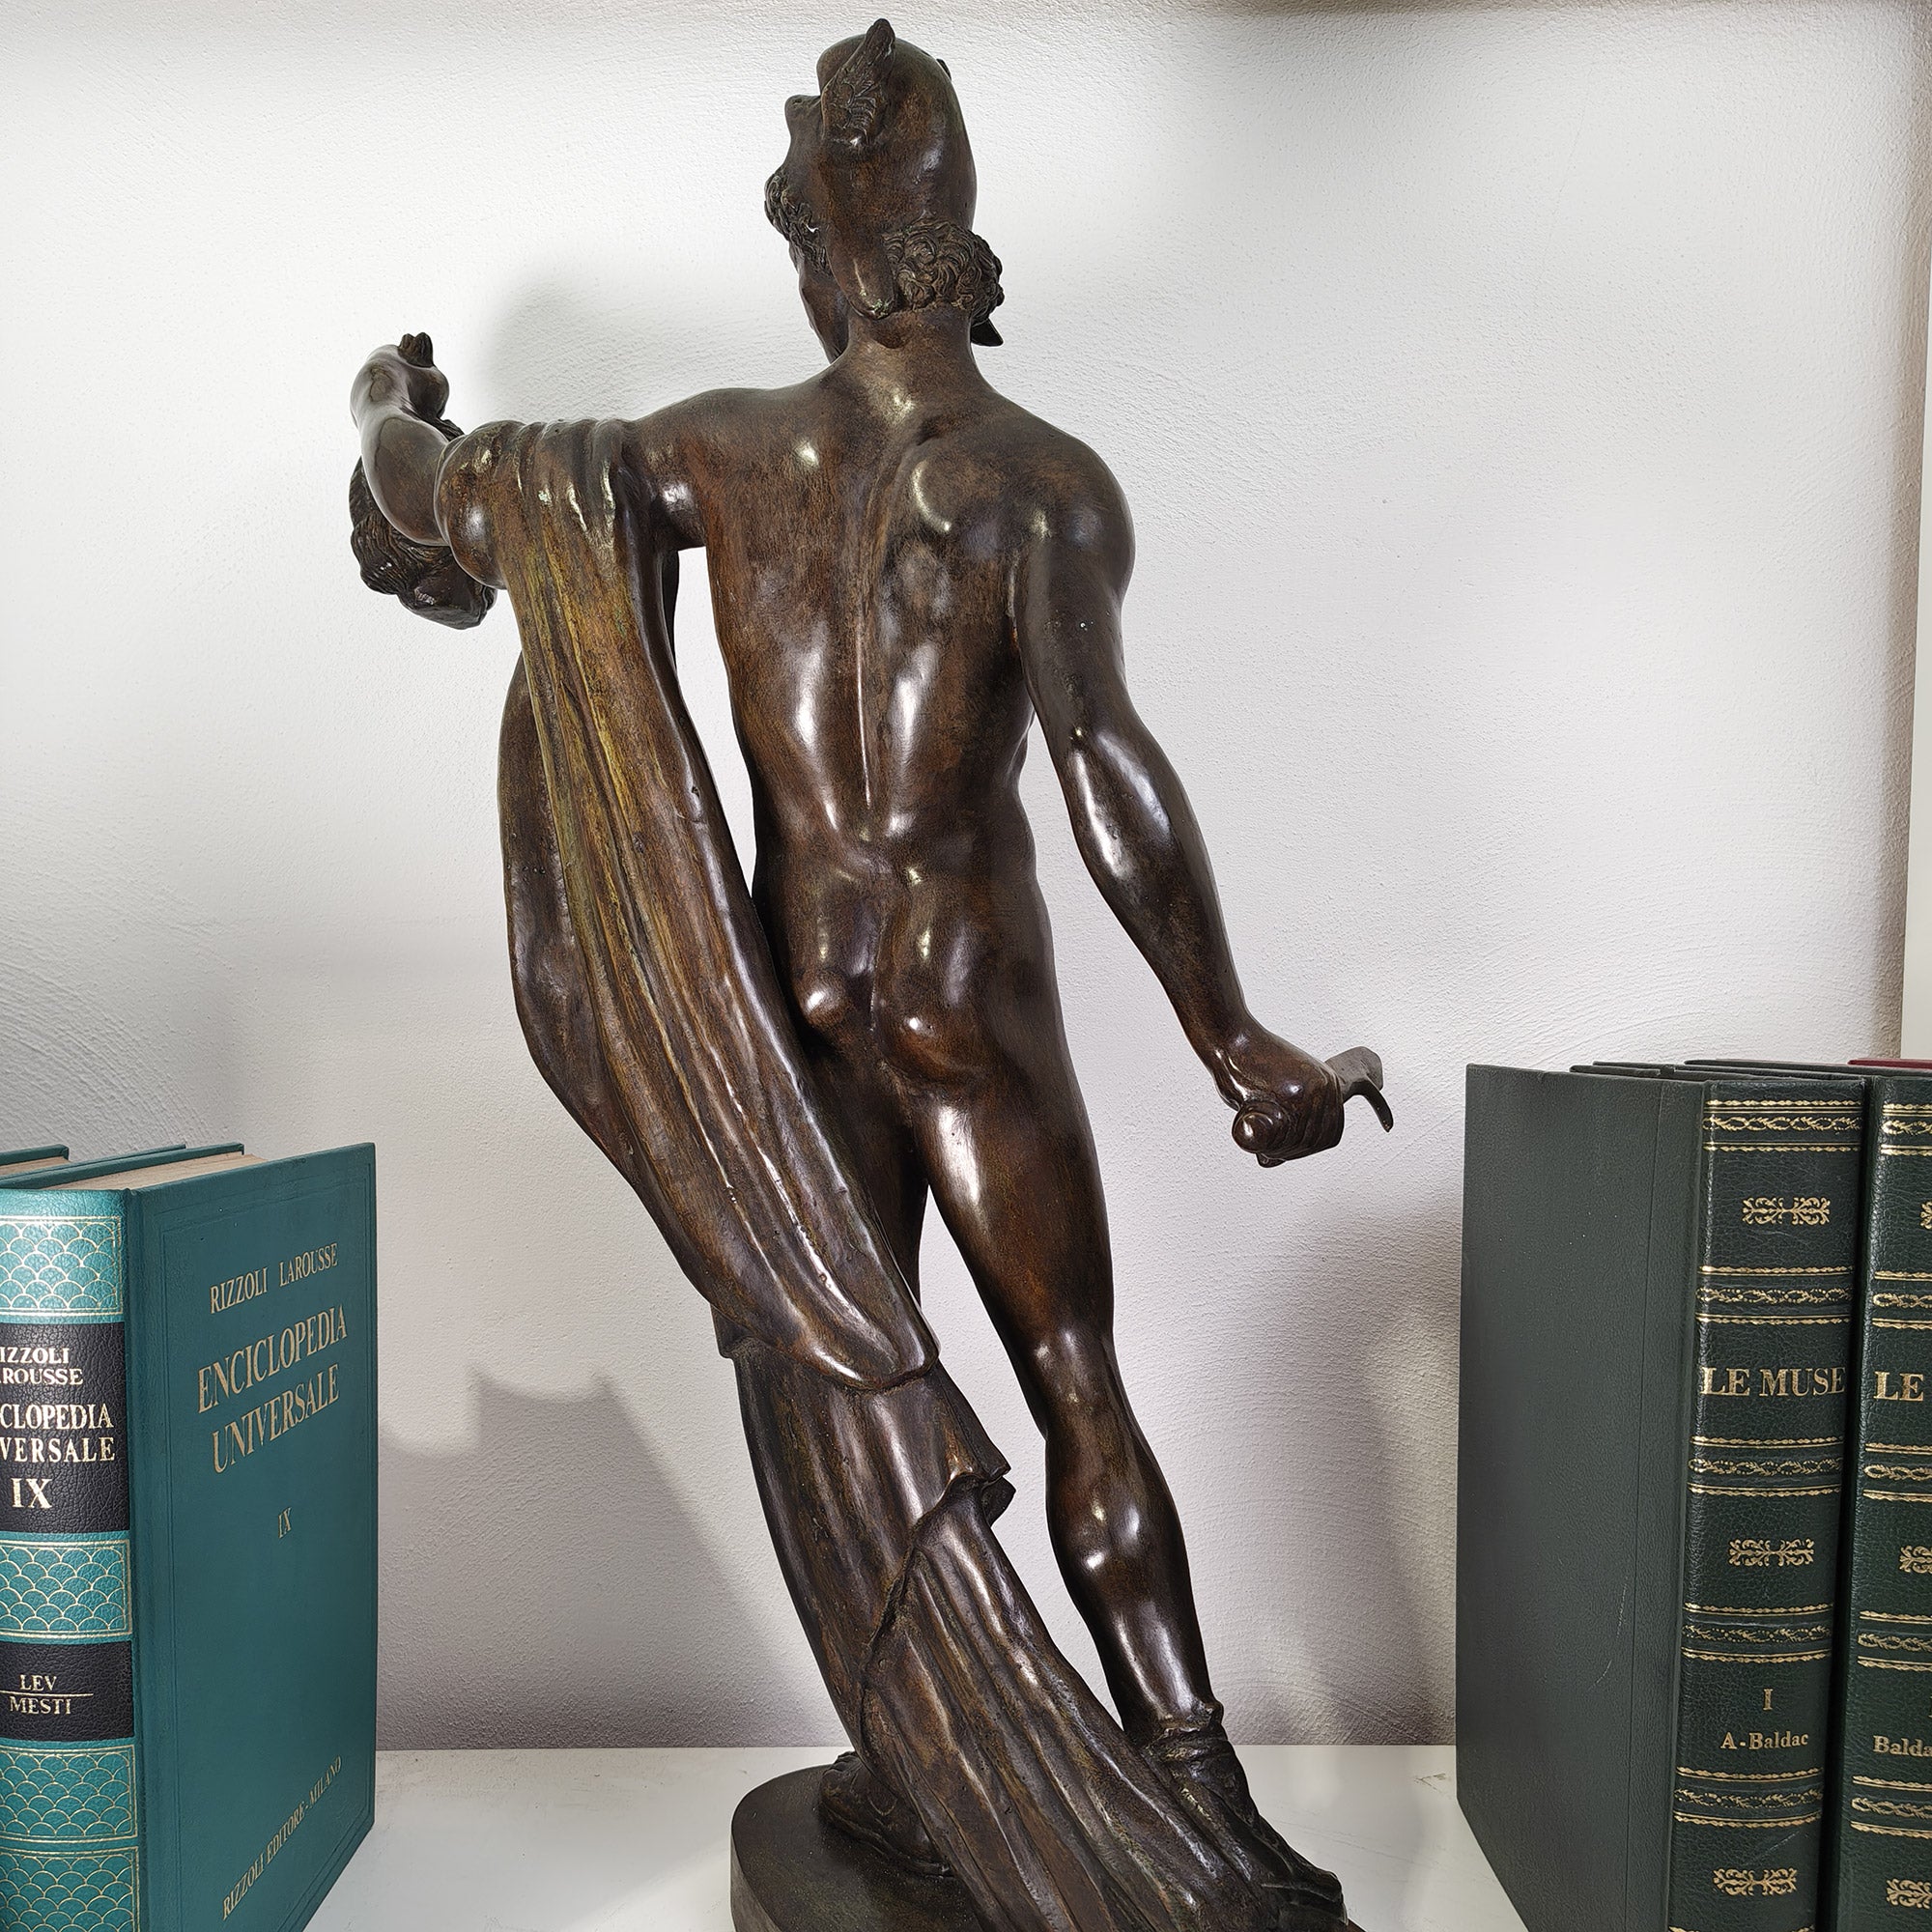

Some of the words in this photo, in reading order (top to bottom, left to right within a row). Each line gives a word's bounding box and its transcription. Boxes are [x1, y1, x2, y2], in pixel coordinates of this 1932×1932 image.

[210, 1267, 268, 1314] RIZZOLI
[279, 1242, 338, 1288] LAROUSSE
[197, 1304, 348, 1414] ENCICLOPEDIA
[0, 1368, 83, 1385] ROUSSE
[1700, 1366, 1750, 1397] LE
[1759, 1366, 1846, 1397] MUSE
[1873, 1371, 1924, 1402] LE
[212, 1364, 339, 1474] UNIVERSALE
[11, 1478, 52, 1509] IX
[278, 1508, 292, 1539] IX
[19, 1674, 57, 1691] LEV
[9, 1696, 71, 1715] MESTI
[1763, 1688, 1774, 1711] I
[222, 1853, 265, 1921] RIZZOLI
